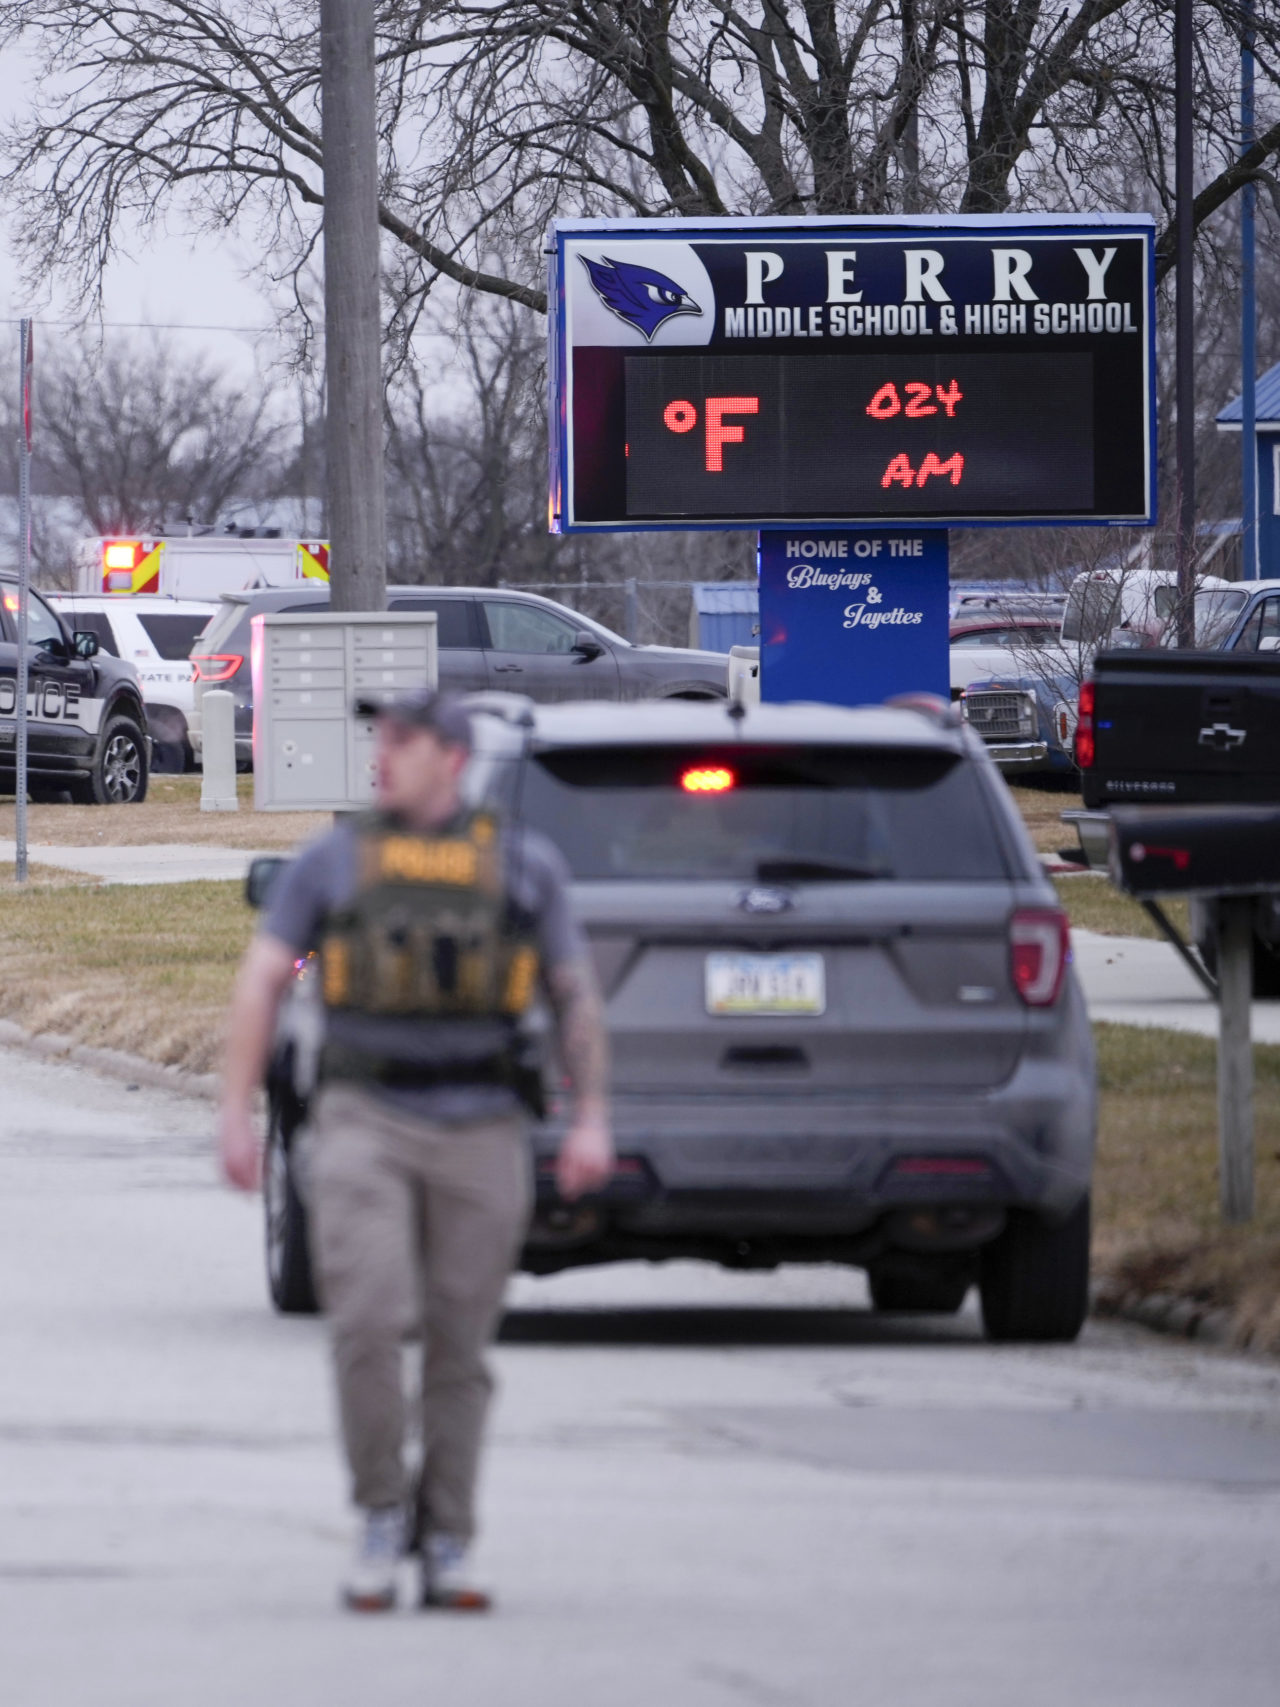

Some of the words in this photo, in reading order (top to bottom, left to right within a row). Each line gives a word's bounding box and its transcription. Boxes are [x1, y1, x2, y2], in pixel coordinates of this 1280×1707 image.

[744, 247, 1118, 304] PERRY
[724, 307, 823, 338] MIDDLE
[829, 304, 933, 336] SCHOOL
[939, 304, 959, 335] &
[964, 303, 1027, 335] HIGH
[1033, 302, 1138, 334] SCHOOL
[866, 379, 963, 419] 024
[880, 452, 964, 487] AM
[786, 540, 848, 558] HOME
[854, 540, 882, 557] OF
[888, 539, 923, 557] THE
[786, 564, 873, 590] Bluejays
[866, 586, 882, 604] &
[843, 603, 924, 629] Jayettes
